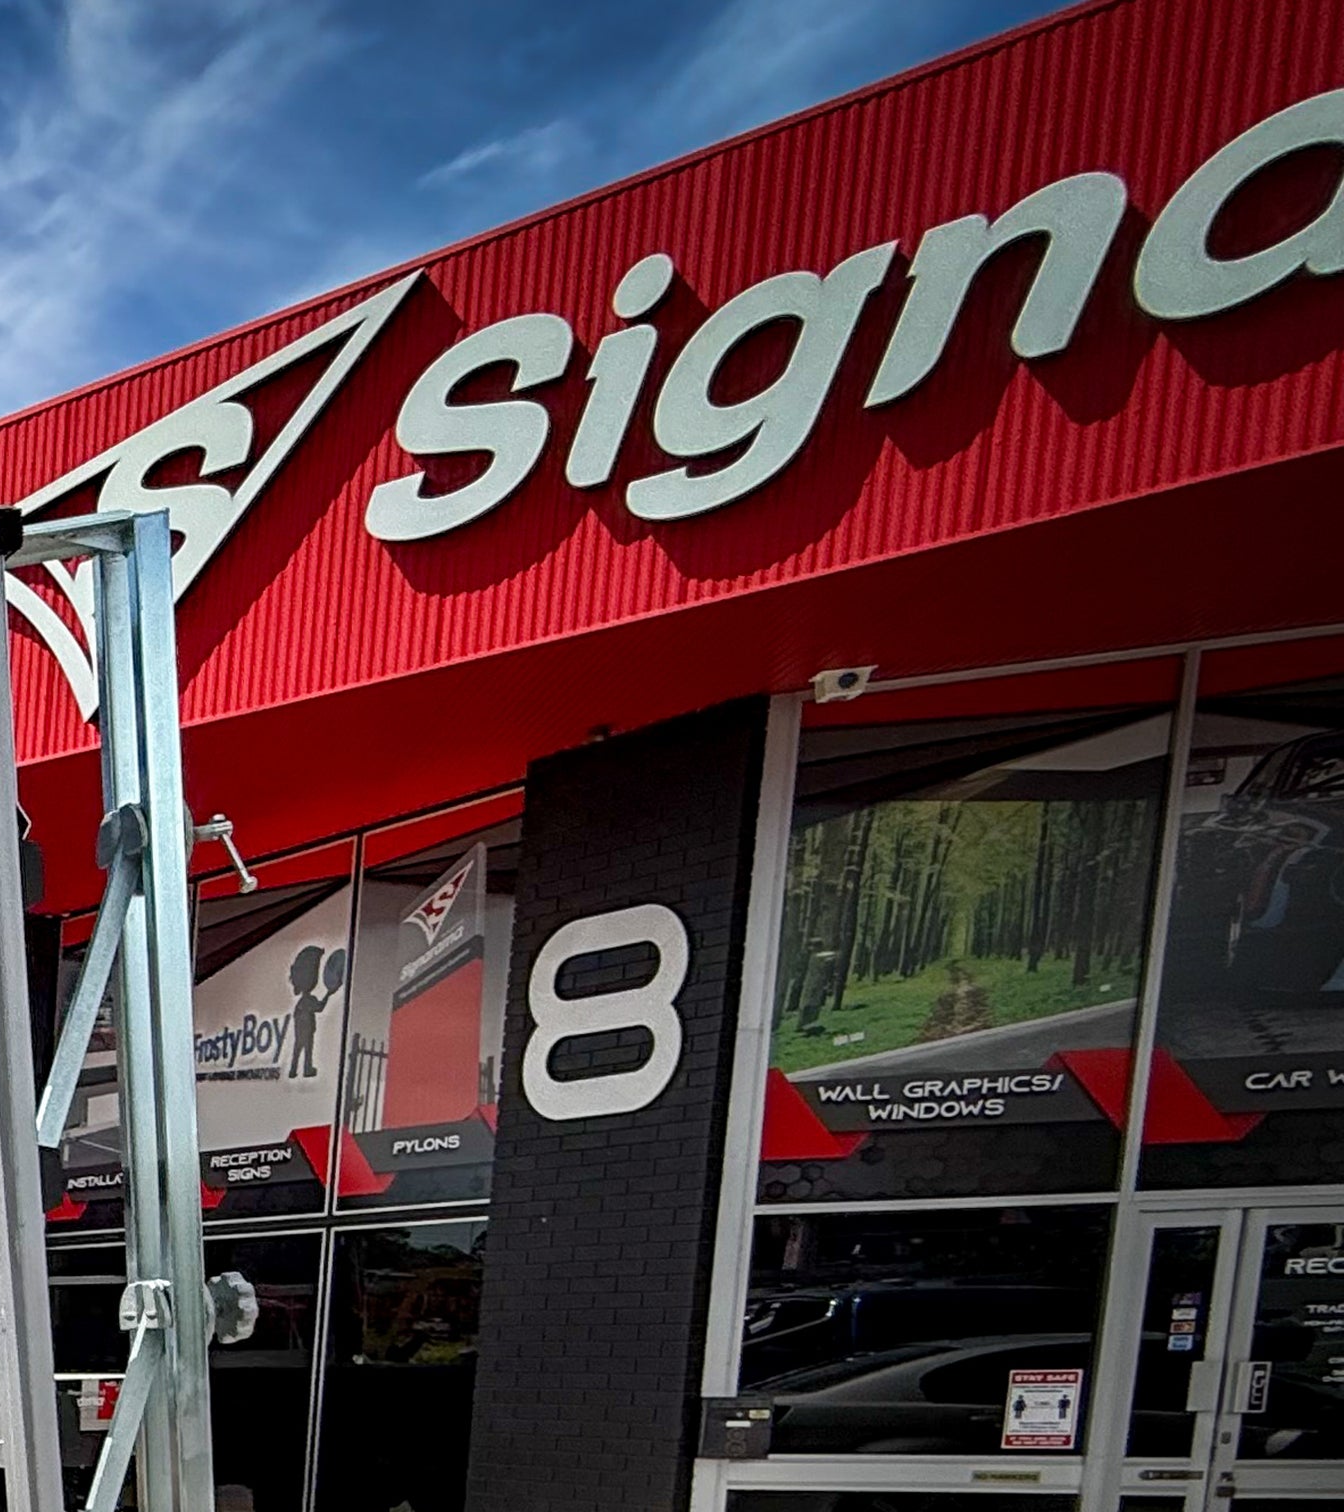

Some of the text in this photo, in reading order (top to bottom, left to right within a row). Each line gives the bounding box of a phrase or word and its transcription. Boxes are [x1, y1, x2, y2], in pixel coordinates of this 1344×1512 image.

[522, 903, 689, 1121] 8
[819, 1074, 1064, 1101] WALL GRAPHICS/
[1245, 1070, 1312, 1090] CAR
[868, 1098, 1004, 1121] WINDOWS
[393, 1135, 460, 1155] PYLONS
[211, 1148, 291, 1168] RECEPTION
[228, 1166, 271, 1181] SIGNS
[1015, 1374, 1044, 1382] STAY
